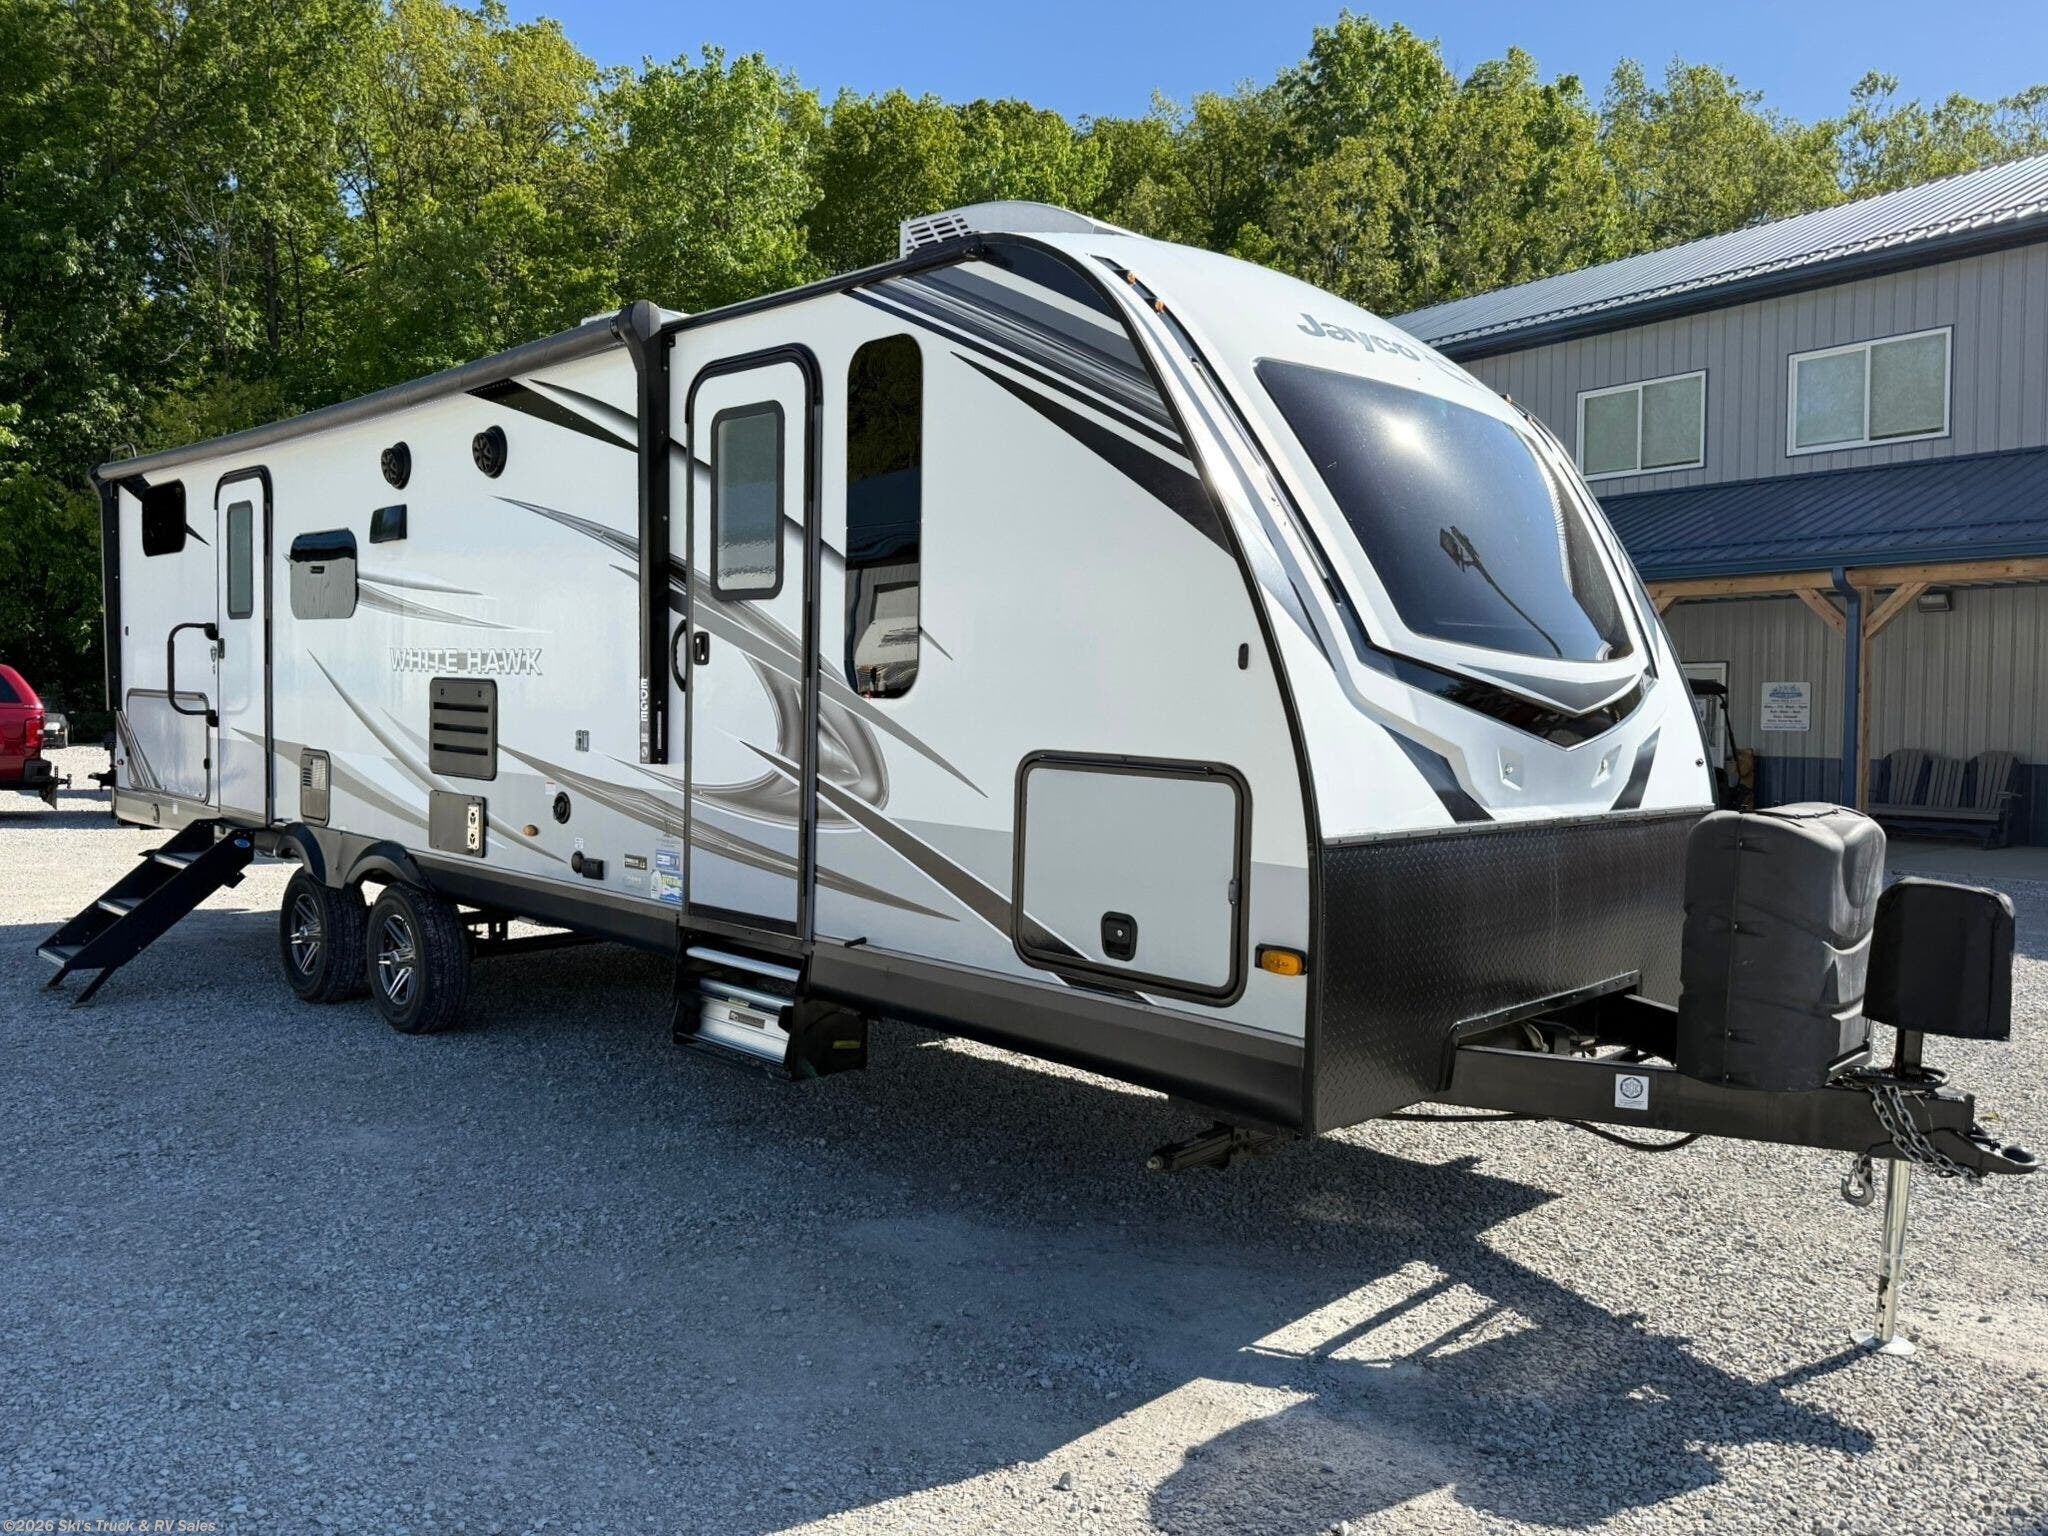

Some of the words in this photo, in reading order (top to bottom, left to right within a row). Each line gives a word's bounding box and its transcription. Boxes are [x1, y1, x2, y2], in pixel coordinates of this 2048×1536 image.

[1296, 312, 1421, 362] Jayco
[389, 648, 459, 673] WHITE
[466, 648, 543, 676] HAWK
[640, 678, 649, 722] EDGE
